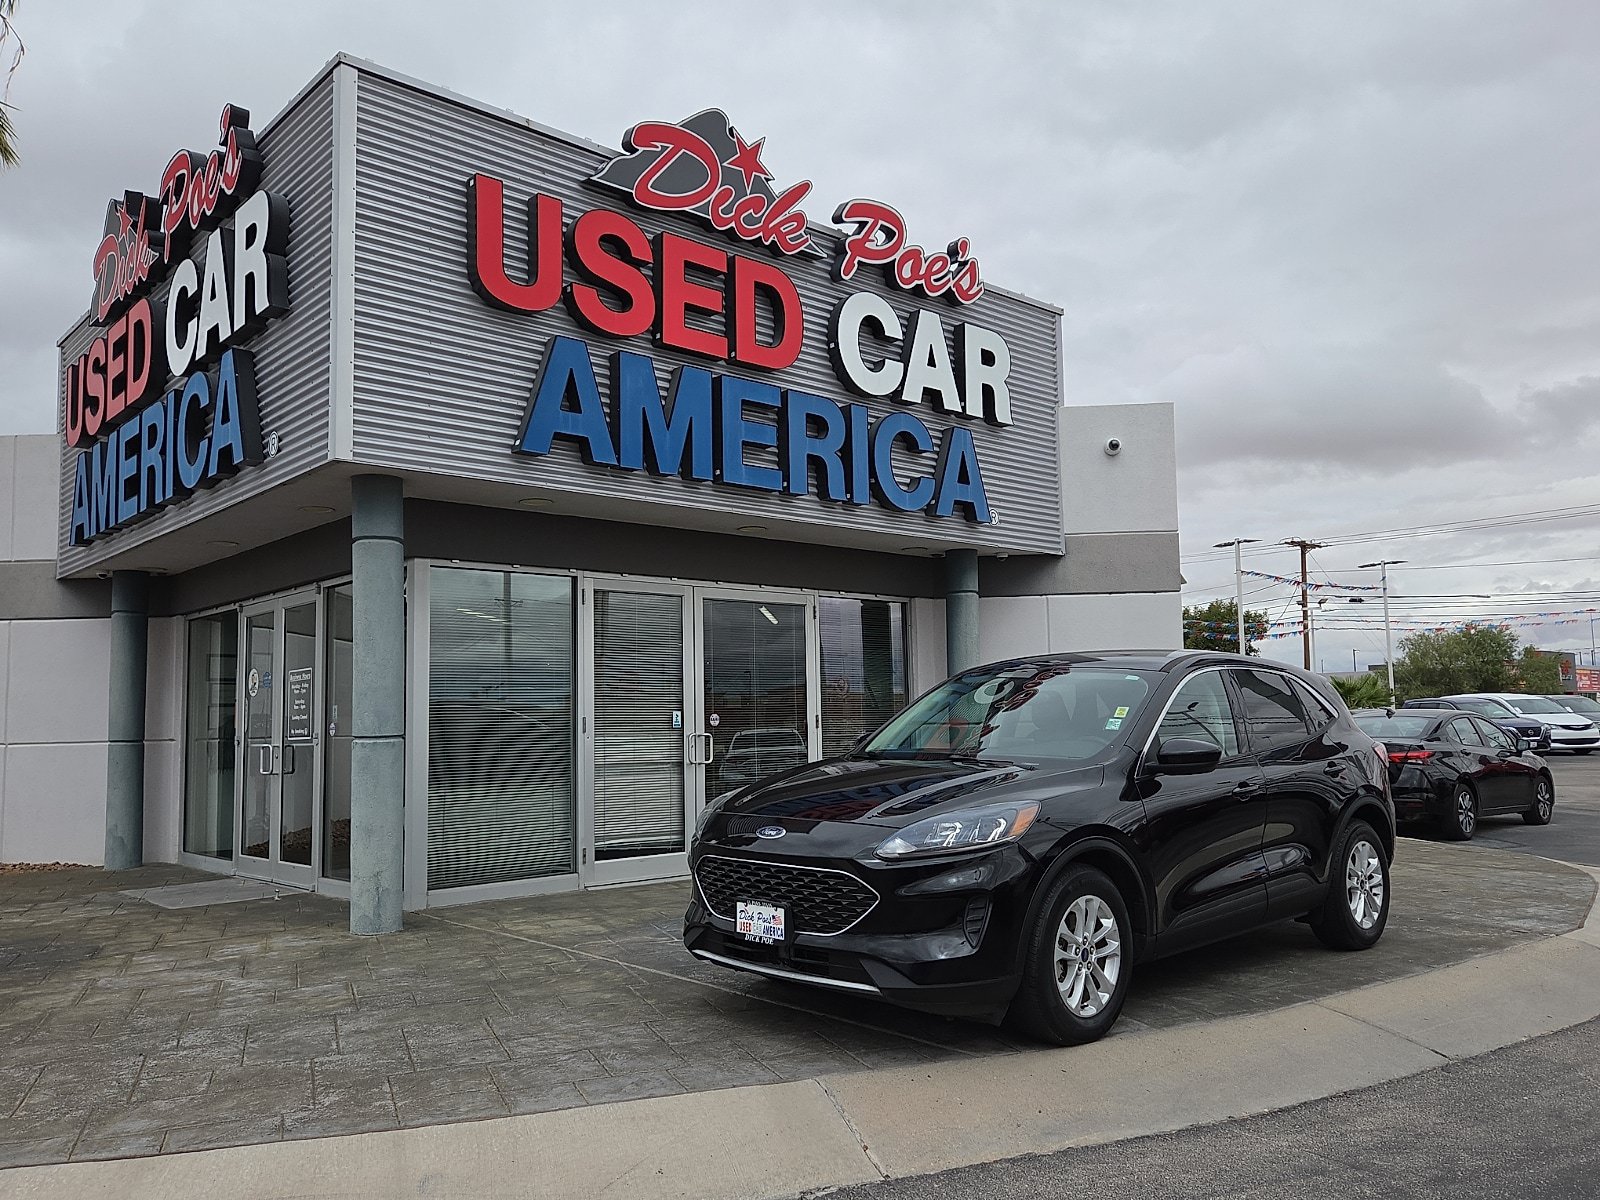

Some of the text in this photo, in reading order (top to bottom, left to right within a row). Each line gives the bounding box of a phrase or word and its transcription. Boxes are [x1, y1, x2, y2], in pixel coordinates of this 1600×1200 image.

[93, 104, 242, 323] Dick Poe's
[475, 173, 1014, 427] USED CAR
[628, 120, 984, 305] Dick Poe's
[66, 189, 271, 448] USED CAR
[69, 349, 245, 547] AMERICA
[518, 335, 992, 525] AMERICA
[739, 921, 752, 933] USED
[763, 924, 784, 939] AMERICA
[745, 933, 775, 946] DICK POE
